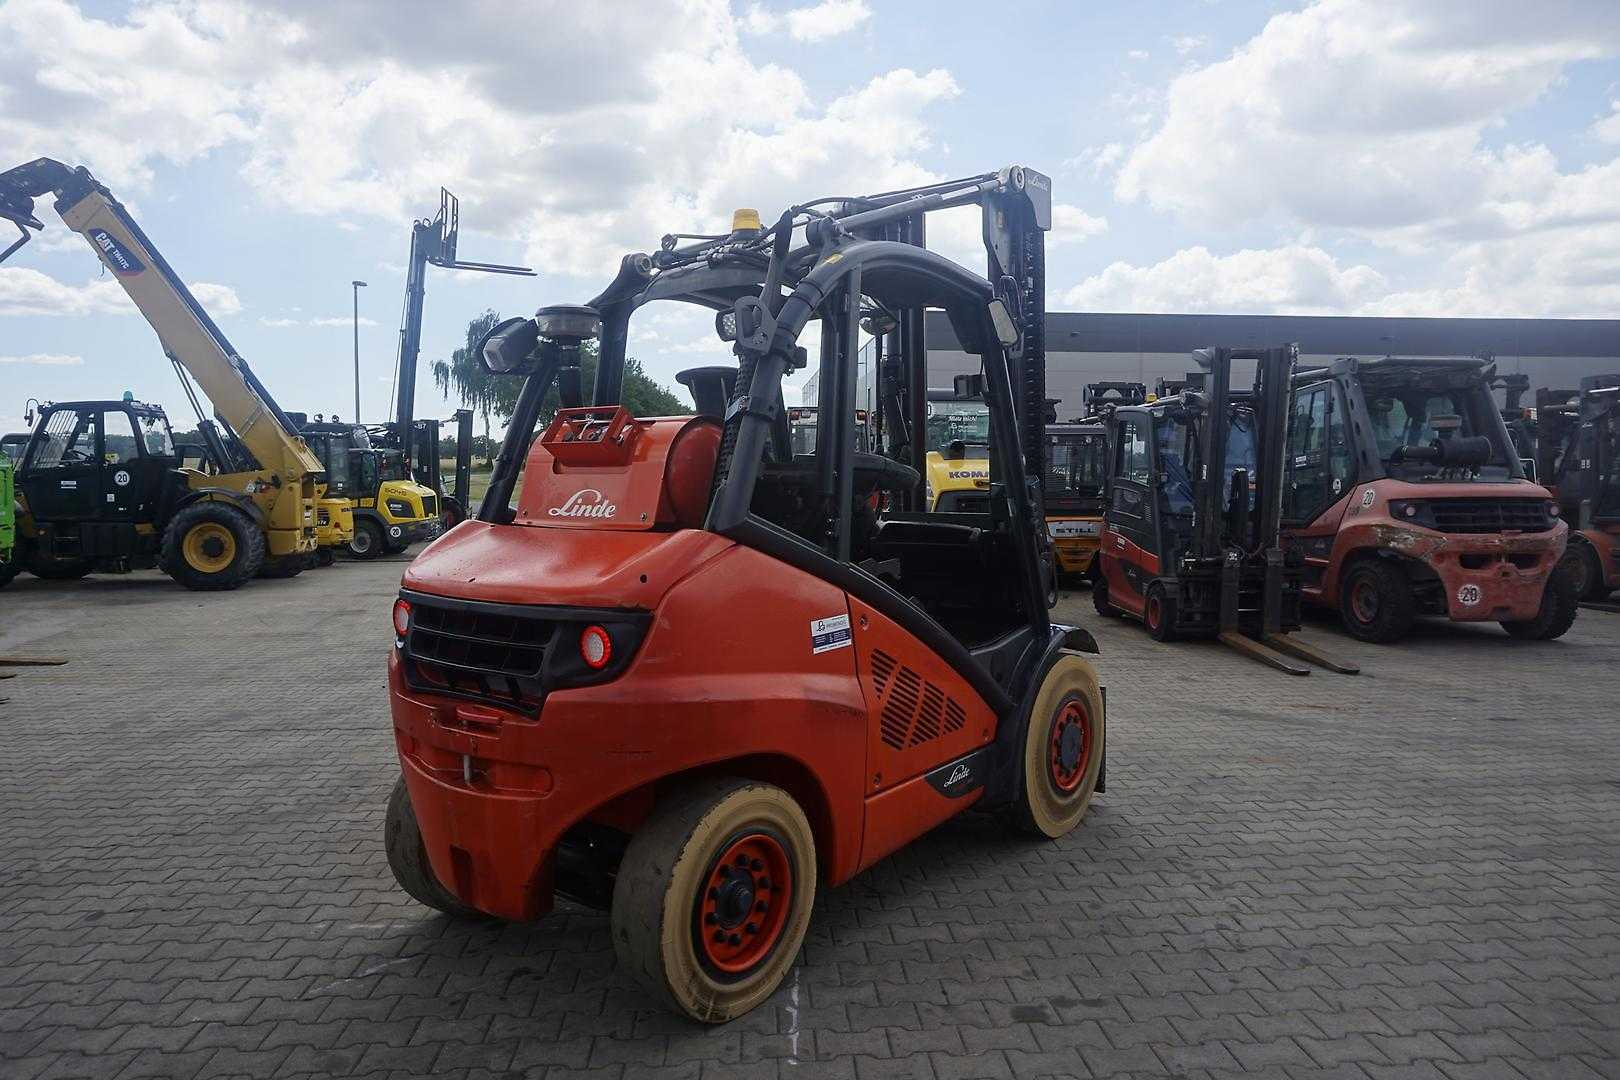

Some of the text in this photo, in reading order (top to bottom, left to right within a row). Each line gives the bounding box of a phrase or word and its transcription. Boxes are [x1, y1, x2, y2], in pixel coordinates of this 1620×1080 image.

[95, 232, 116, 252] CAT
[117, 473, 128, 483] 20
[548, 488, 617, 518] Linde
[1362, 490, 1375, 506] 20
[391, 527, 401, 537] 20
[1462, 586, 1478, 602] 20
[943, 764, 971, 788] Linde
